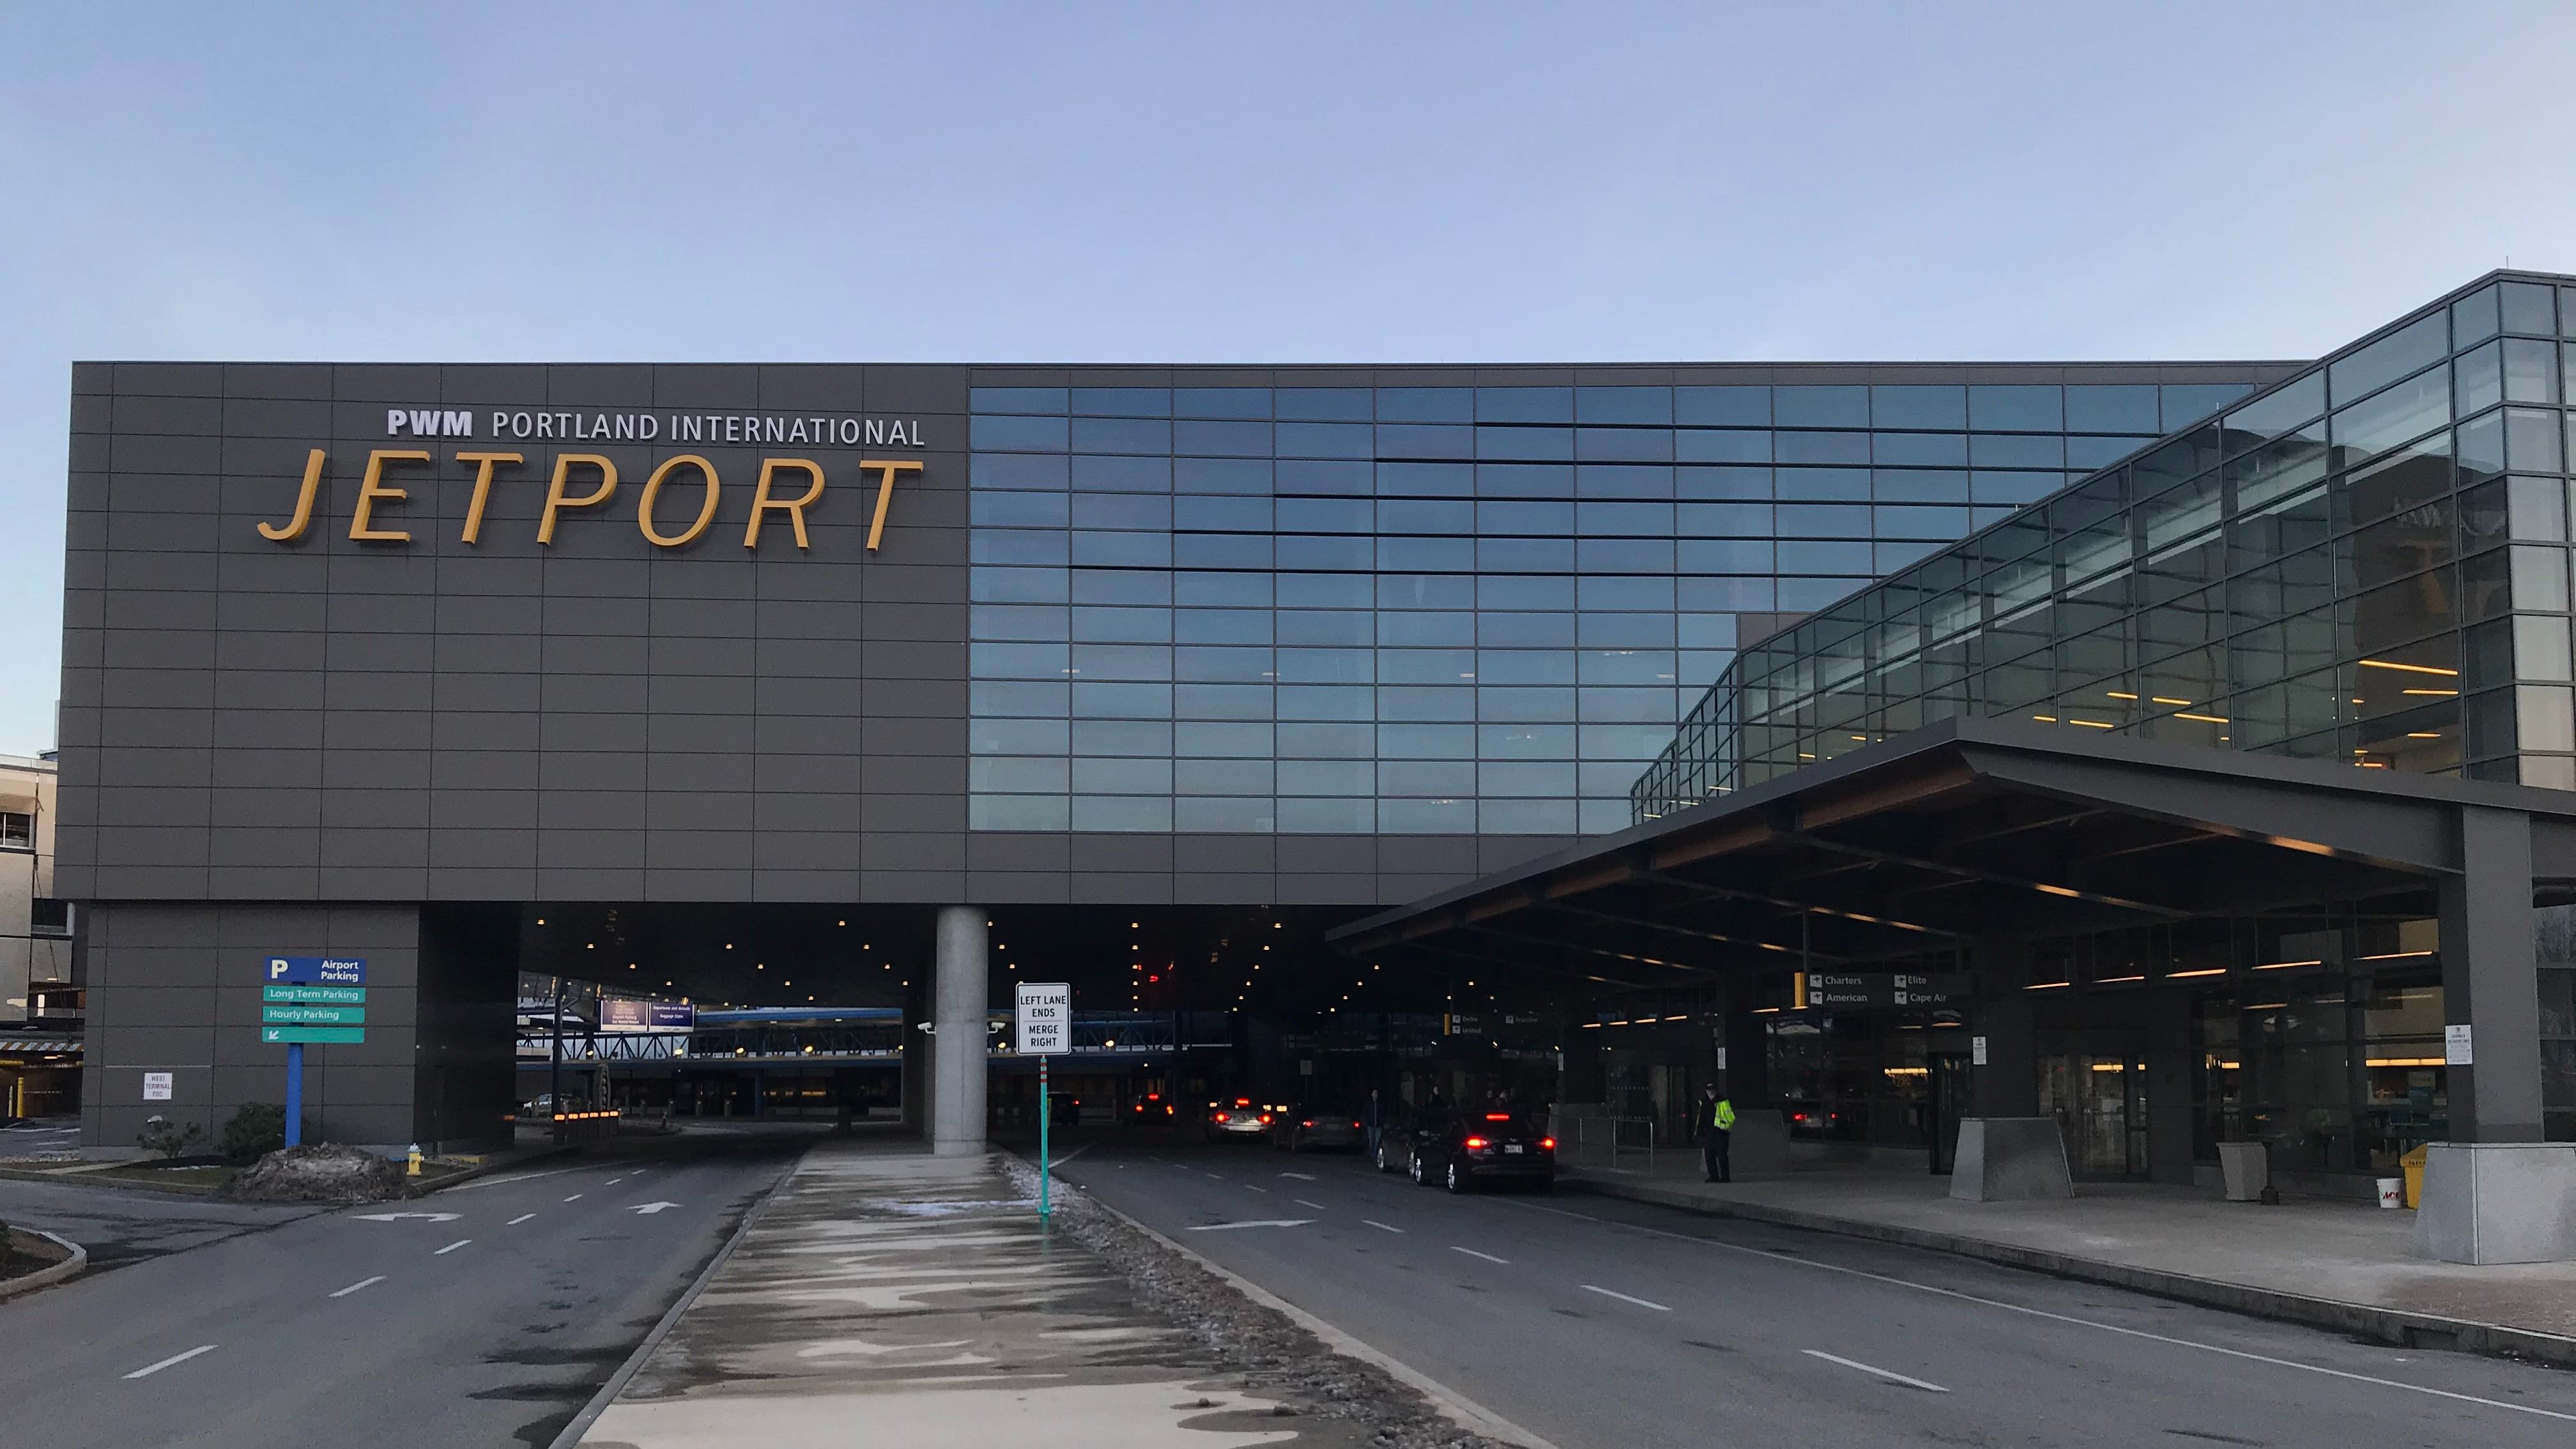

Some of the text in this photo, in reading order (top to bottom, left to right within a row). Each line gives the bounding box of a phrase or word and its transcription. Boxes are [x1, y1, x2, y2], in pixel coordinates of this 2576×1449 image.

[388, 410, 925, 445] PWM PORTLAND INTERNATIONAL
[257, 448, 924, 552] JETPORT
[271, 960, 288, 979] P
[321, 960, 358, 970] Airport
[321, 971, 358, 982] Parking
[1825, 976, 1862, 985] Charters
[1908, 976, 1927, 985] Elite
[270, 990, 358, 1001] Long Term Parking
[1020, 995, 1066, 1005] LEFT LANE
[1826, 993, 1867, 1002] American
[1910, 993, 1931, 1004] Cape
[270, 1010, 339, 1020] Hourly Parking
[1032, 1008, 1055, 1017] ENDS
[1029, 1025, 1058, 1034] MERGE
[1031, 1038, 1057, 1046] RIGHT
